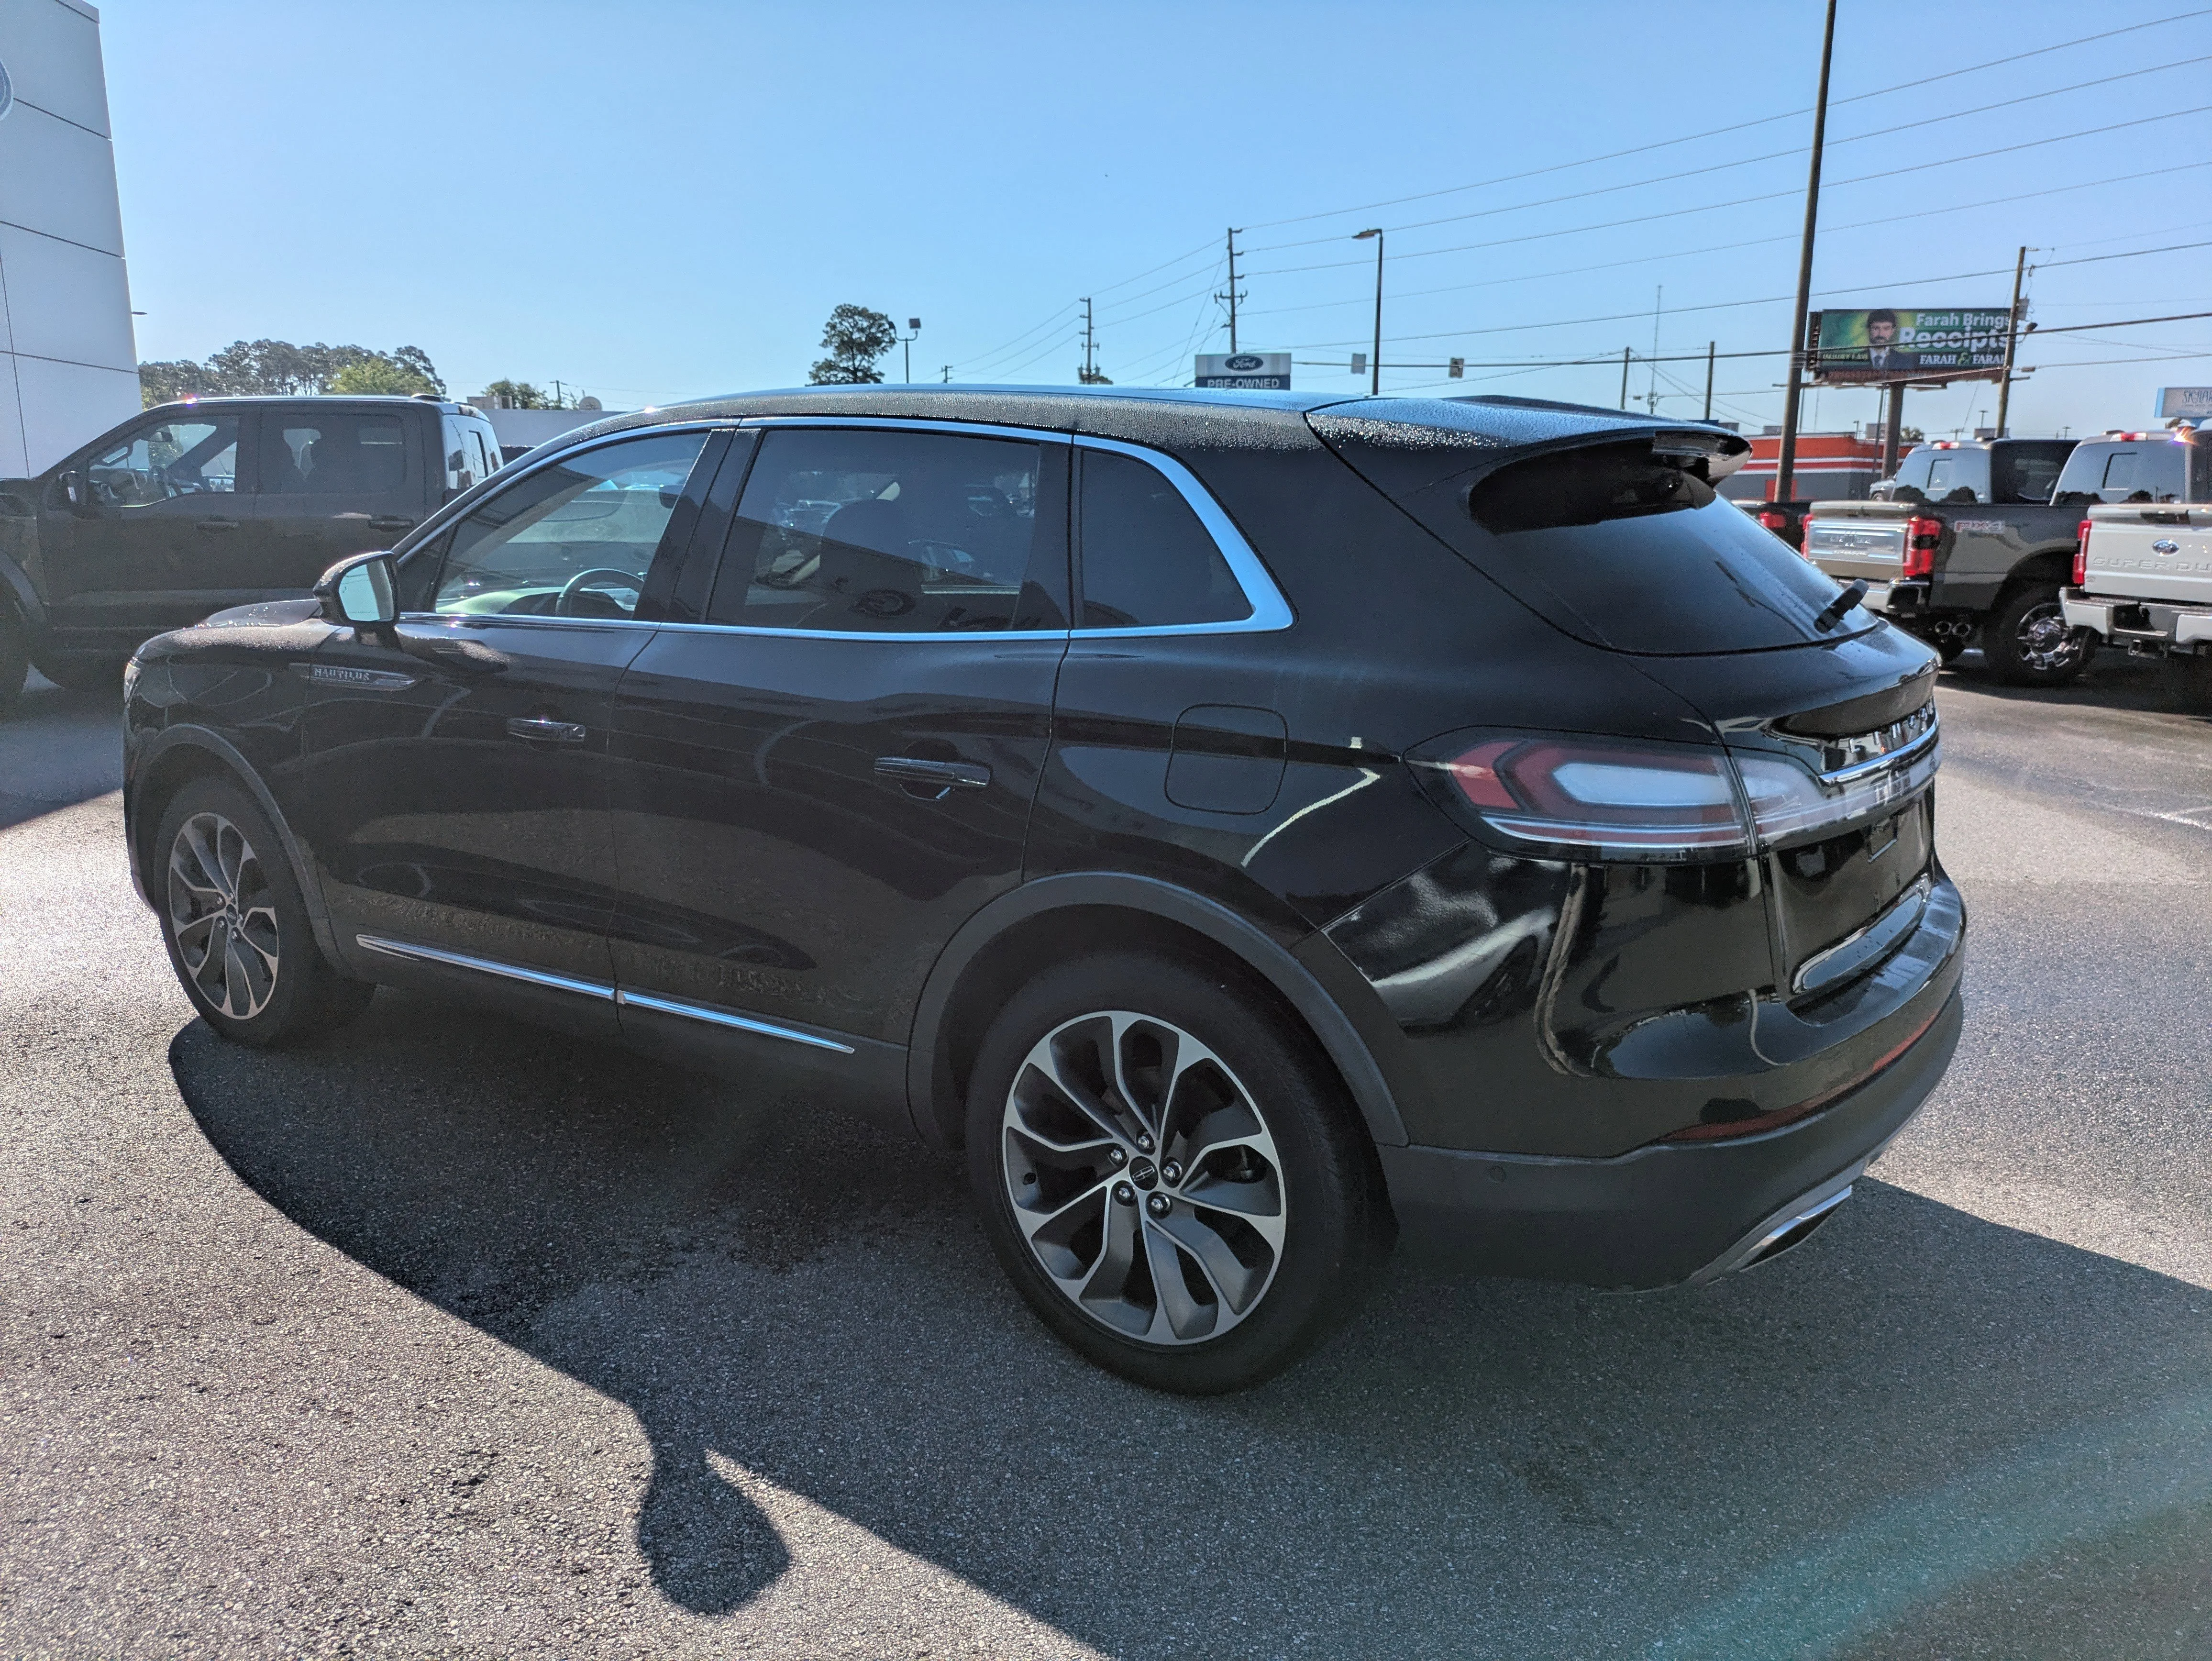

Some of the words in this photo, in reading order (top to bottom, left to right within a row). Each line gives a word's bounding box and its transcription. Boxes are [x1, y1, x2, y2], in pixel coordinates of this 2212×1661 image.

[1916, 313, 1959, 326] Farah
[1963, 313, 2009, 329] Brings
[1899, 326, 2009, 353] Receipts
[1233, 357, 1257, 368] Ford
[1920, 354, 1957, 365] FARAH
[1207, 378, 1280, 388] PRE-OWNED
[2092, 556, 2170, 570] SUPER
[314, 668, 370, 681] NAUTILUS
